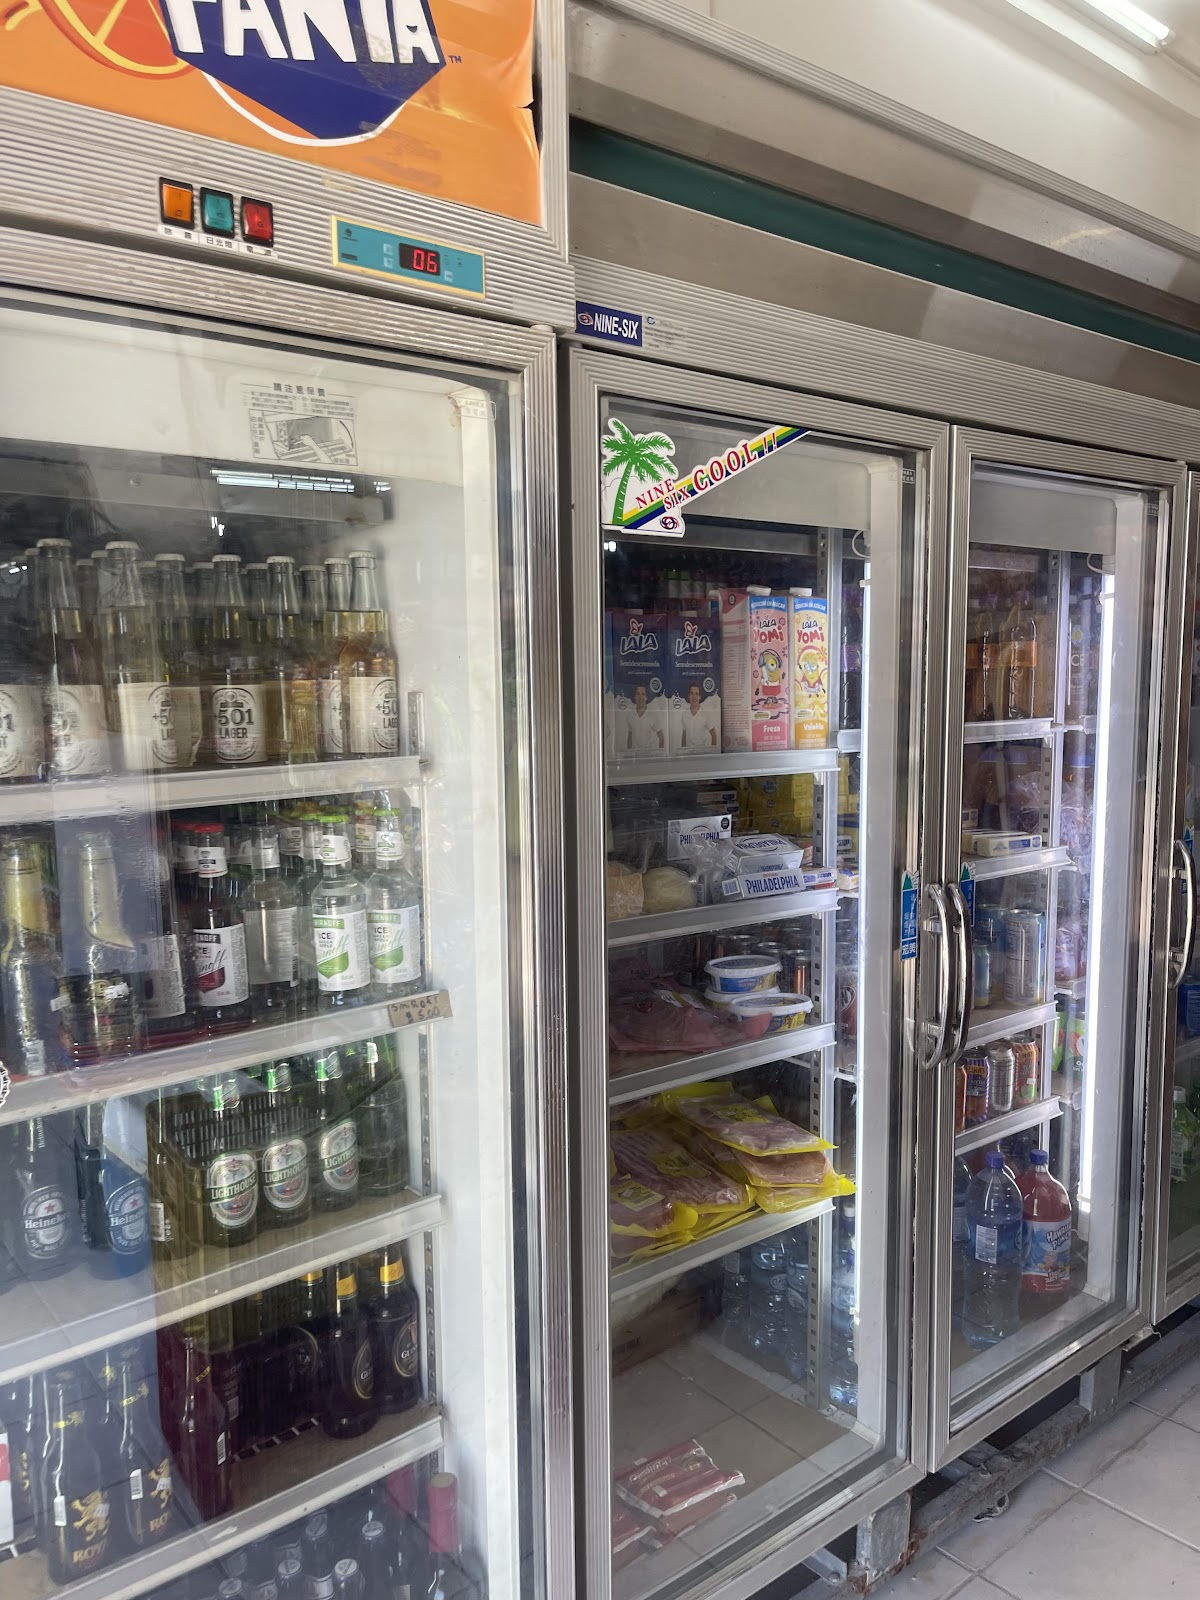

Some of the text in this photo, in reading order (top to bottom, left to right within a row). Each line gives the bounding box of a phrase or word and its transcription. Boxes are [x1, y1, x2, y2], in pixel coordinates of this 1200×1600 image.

[413, 249, 437, 273] 06
[594, 312, 638, 340] NINE-SIX
[663, 486, 691, 510] SIX
[693, 442, 757, 491] COOL
[635, 478, 675, 509] NINE
[620, 633, 658, 655] LALA
[676, 635, 712, 656] LALA
[220, 727, 249, 739] LAGER
[763, 725, 780, 733] Fresa
[745, 874, 800, 894] PHILADELPHIA
[319, 932, 332, 940] ICE
[374, 926, 388, 934] ICE
[211, 1173, 258, 1200] LIGHTHOUSE
